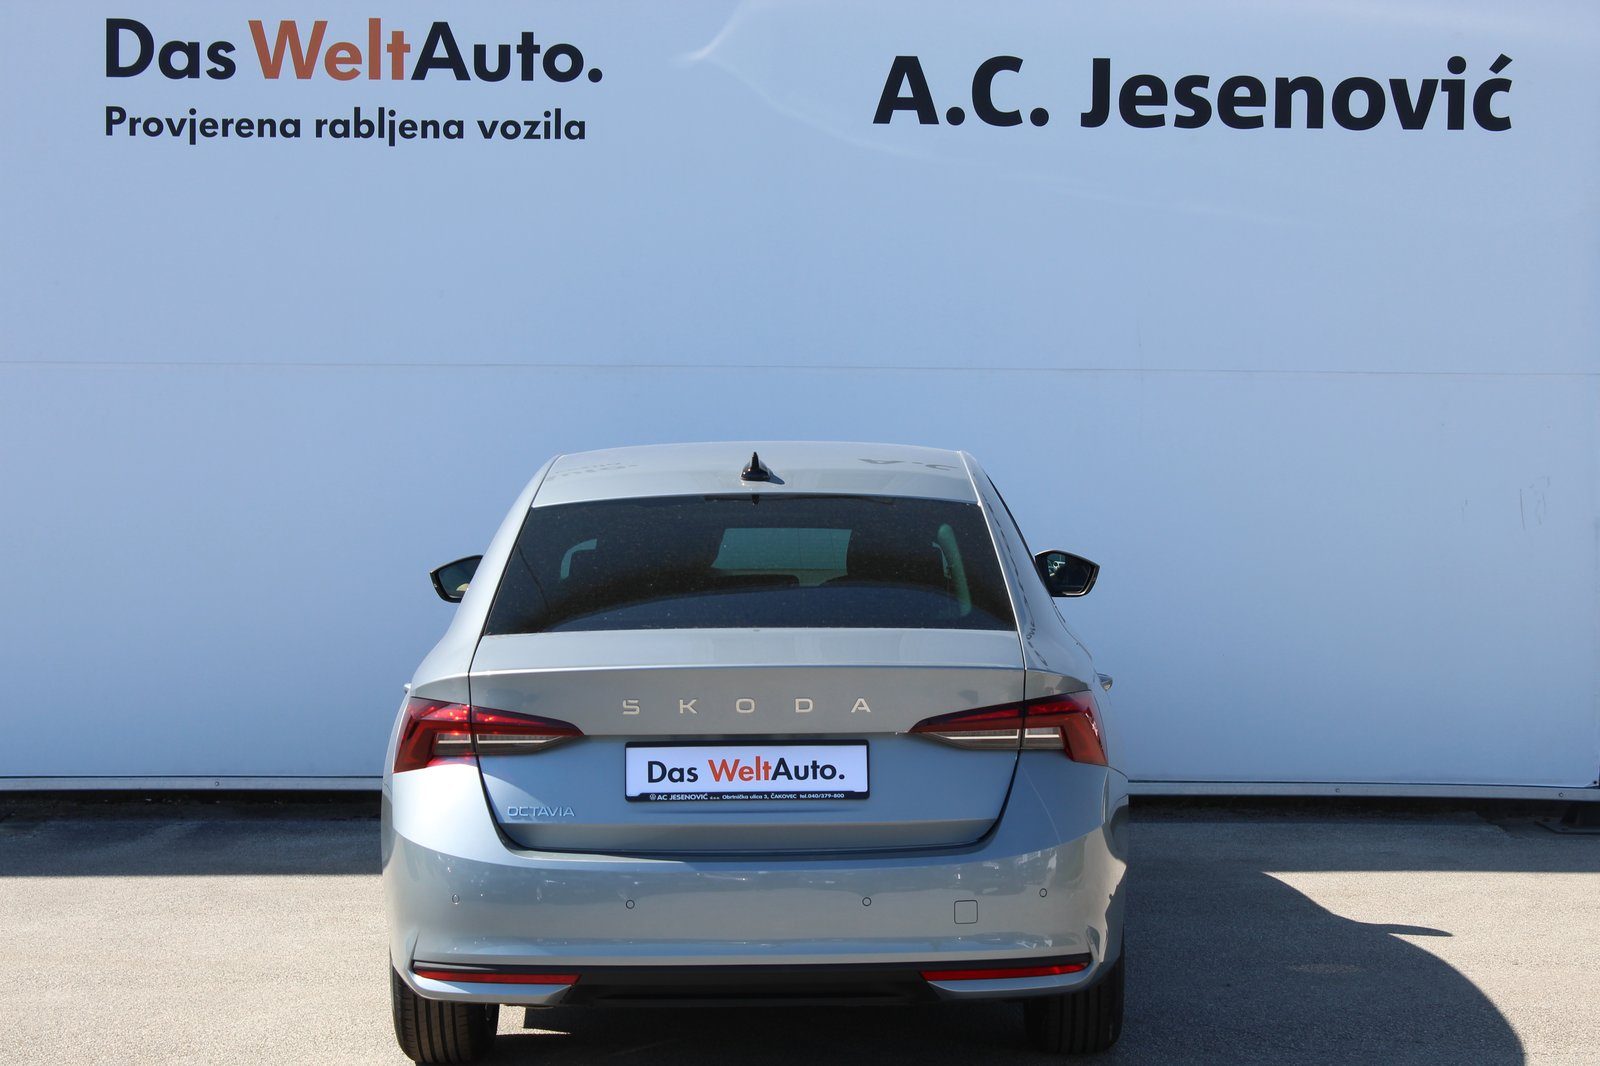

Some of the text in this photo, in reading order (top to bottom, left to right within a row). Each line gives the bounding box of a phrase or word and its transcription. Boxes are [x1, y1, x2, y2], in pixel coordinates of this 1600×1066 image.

[105, 17, 603, 83] Das WeltAuto.
[873, 53, 1513, 132] A.C. Jesenović
[105, 105, 586, 147] Provjerena rabljena vozila
[647, 755, 846, 784] Das WeltAuto.
[507, 805, 575, 817] OCTAVIA
[657, 793, 668, 801] AC
[669, 792, 709, 801] JESENOVIĆ
